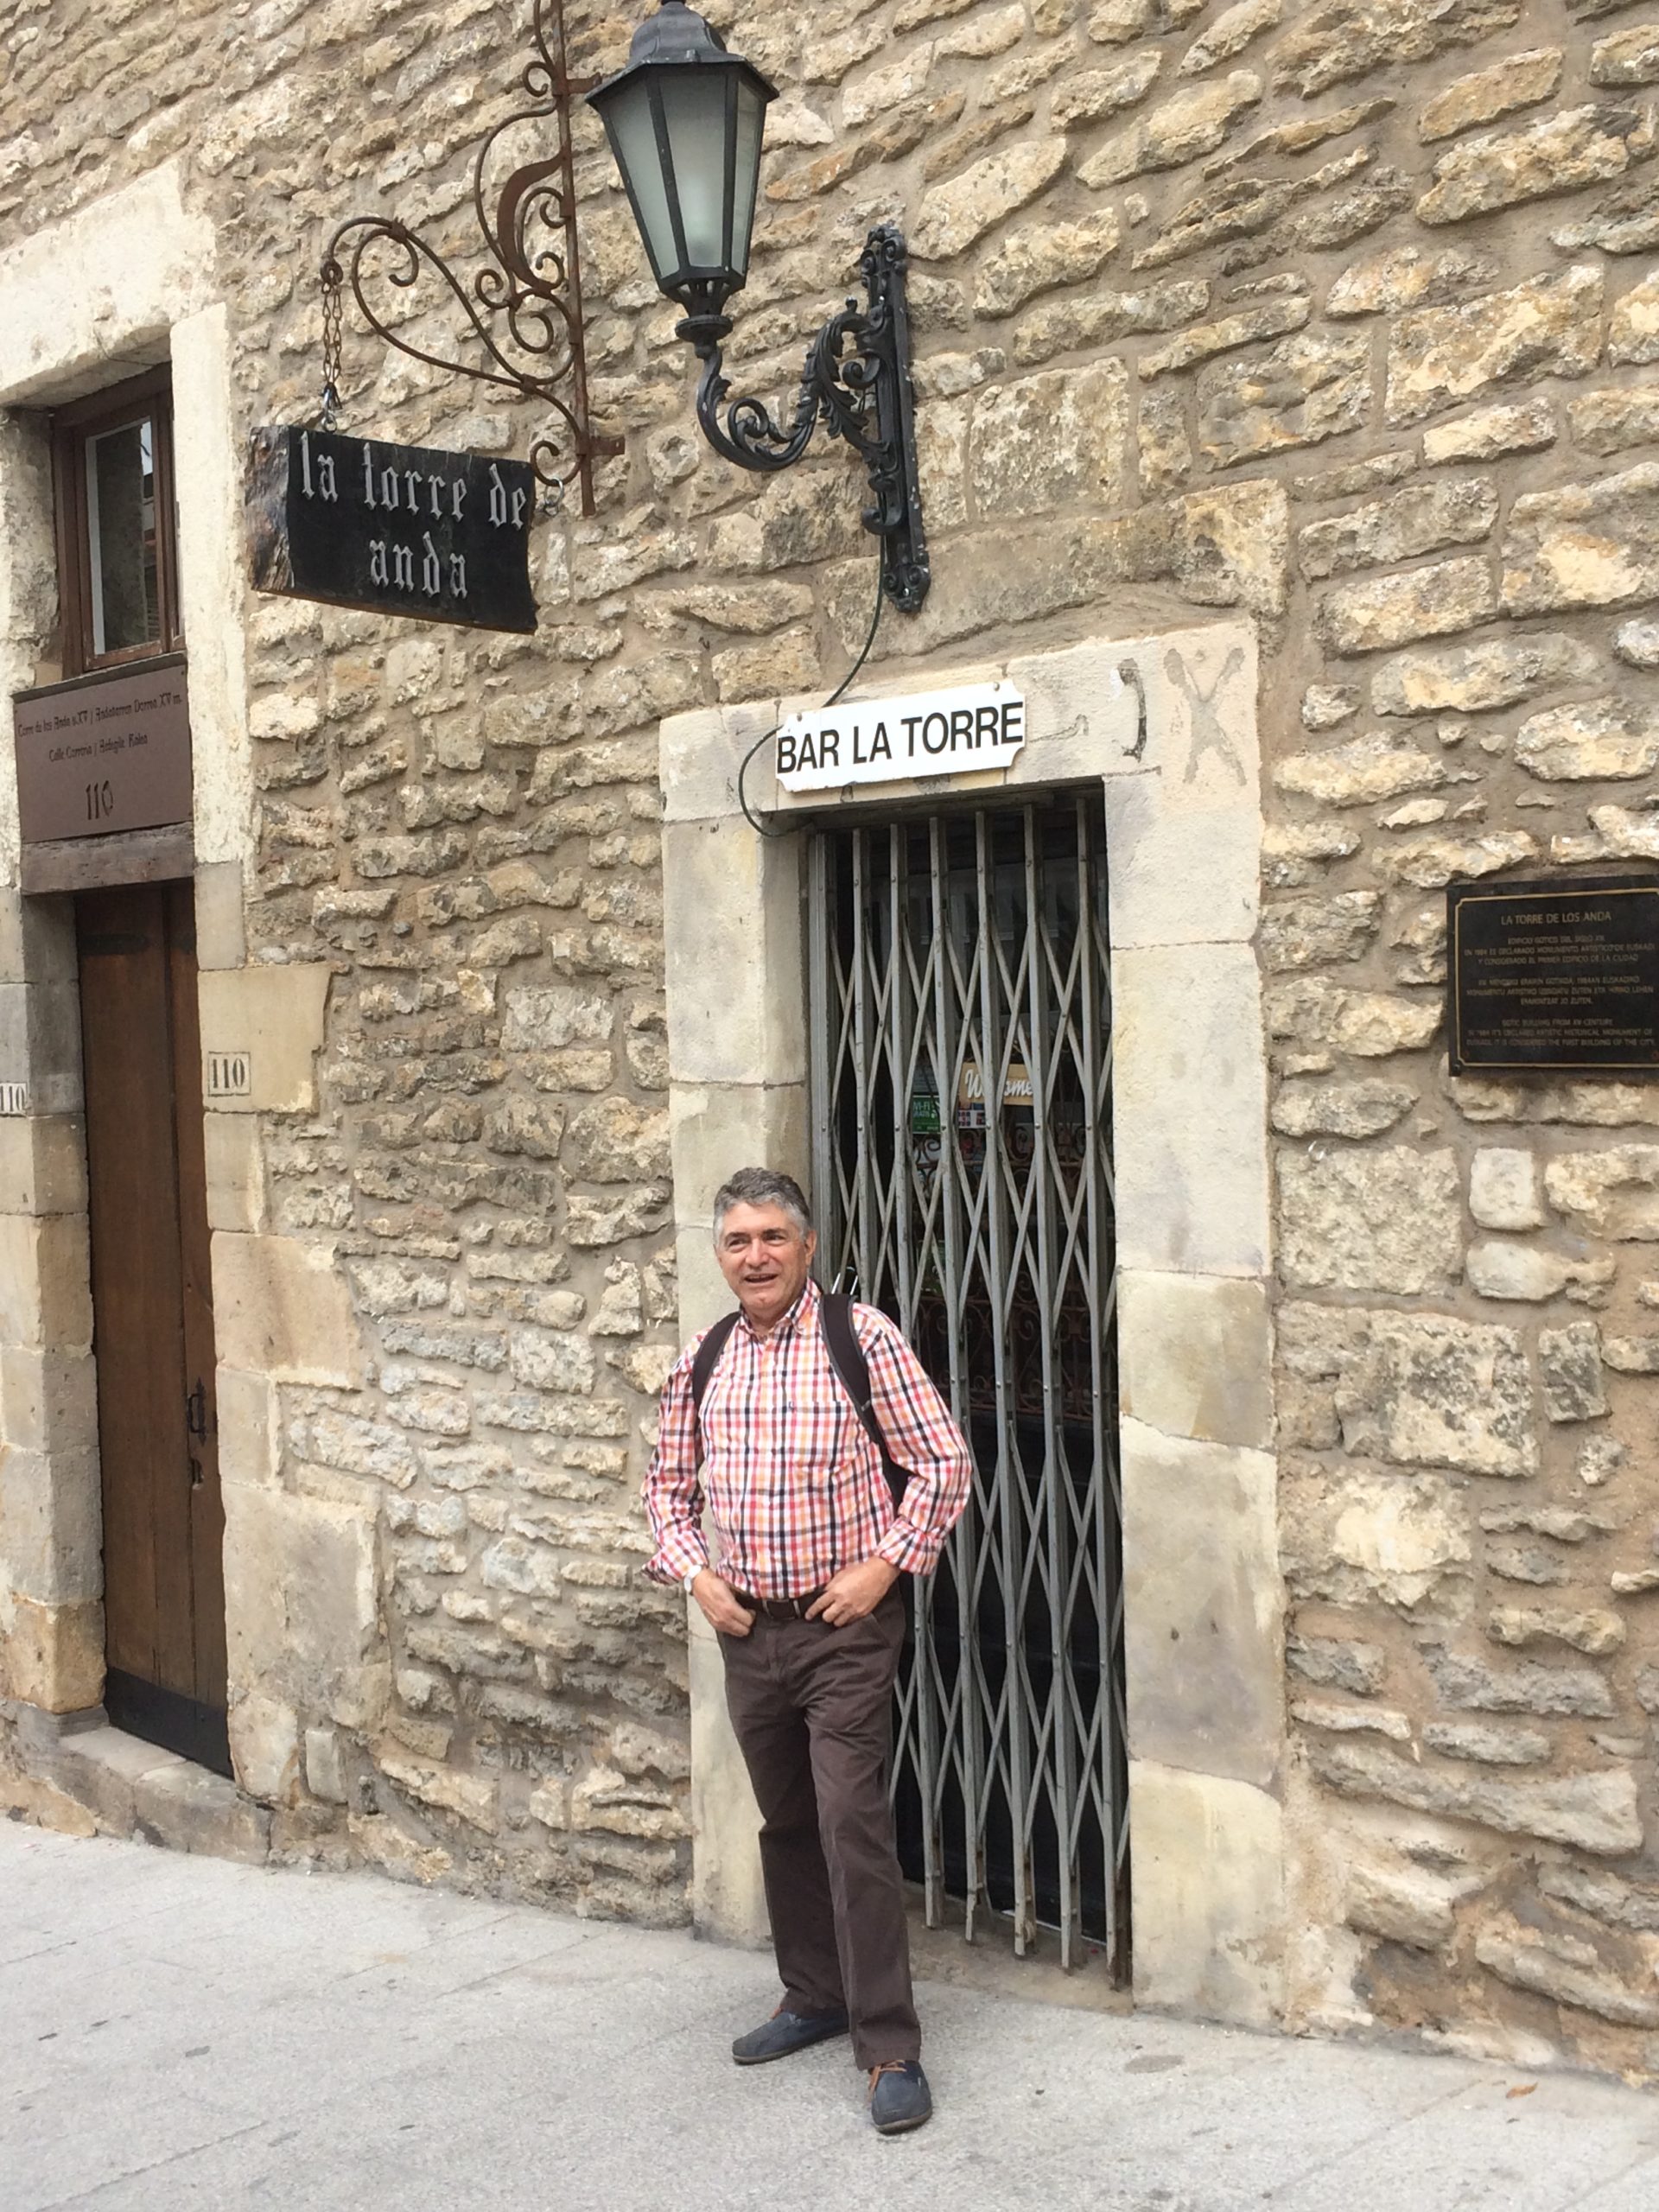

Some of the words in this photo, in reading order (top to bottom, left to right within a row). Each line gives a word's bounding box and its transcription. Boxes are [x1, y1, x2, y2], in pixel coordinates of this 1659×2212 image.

[300, 430, 339, 503] la
[361, 442, 467, 522] torre
[488, 462, 527, 531] de
[369, 530, 468, 598] anda
[777, 728, 840, 774] BAR
[853, 721, 892, 765] LA
[900, 701, 1024, 758] TORRE
[86, 779, 114, 820] 110
[1501, 914, 1513, 925] LA
[1515, 913, 1543, 925] TORRE
[1546, 912, 1560, 924] DE
[1561, 912, 1580, 923] LOS
[1583, 911, 1611, 922] ANDA
[1601, 954, 1611, 963] LA
[212, 1058, 246, 1090] 110
[0, 1084, 26, 1112] 110
